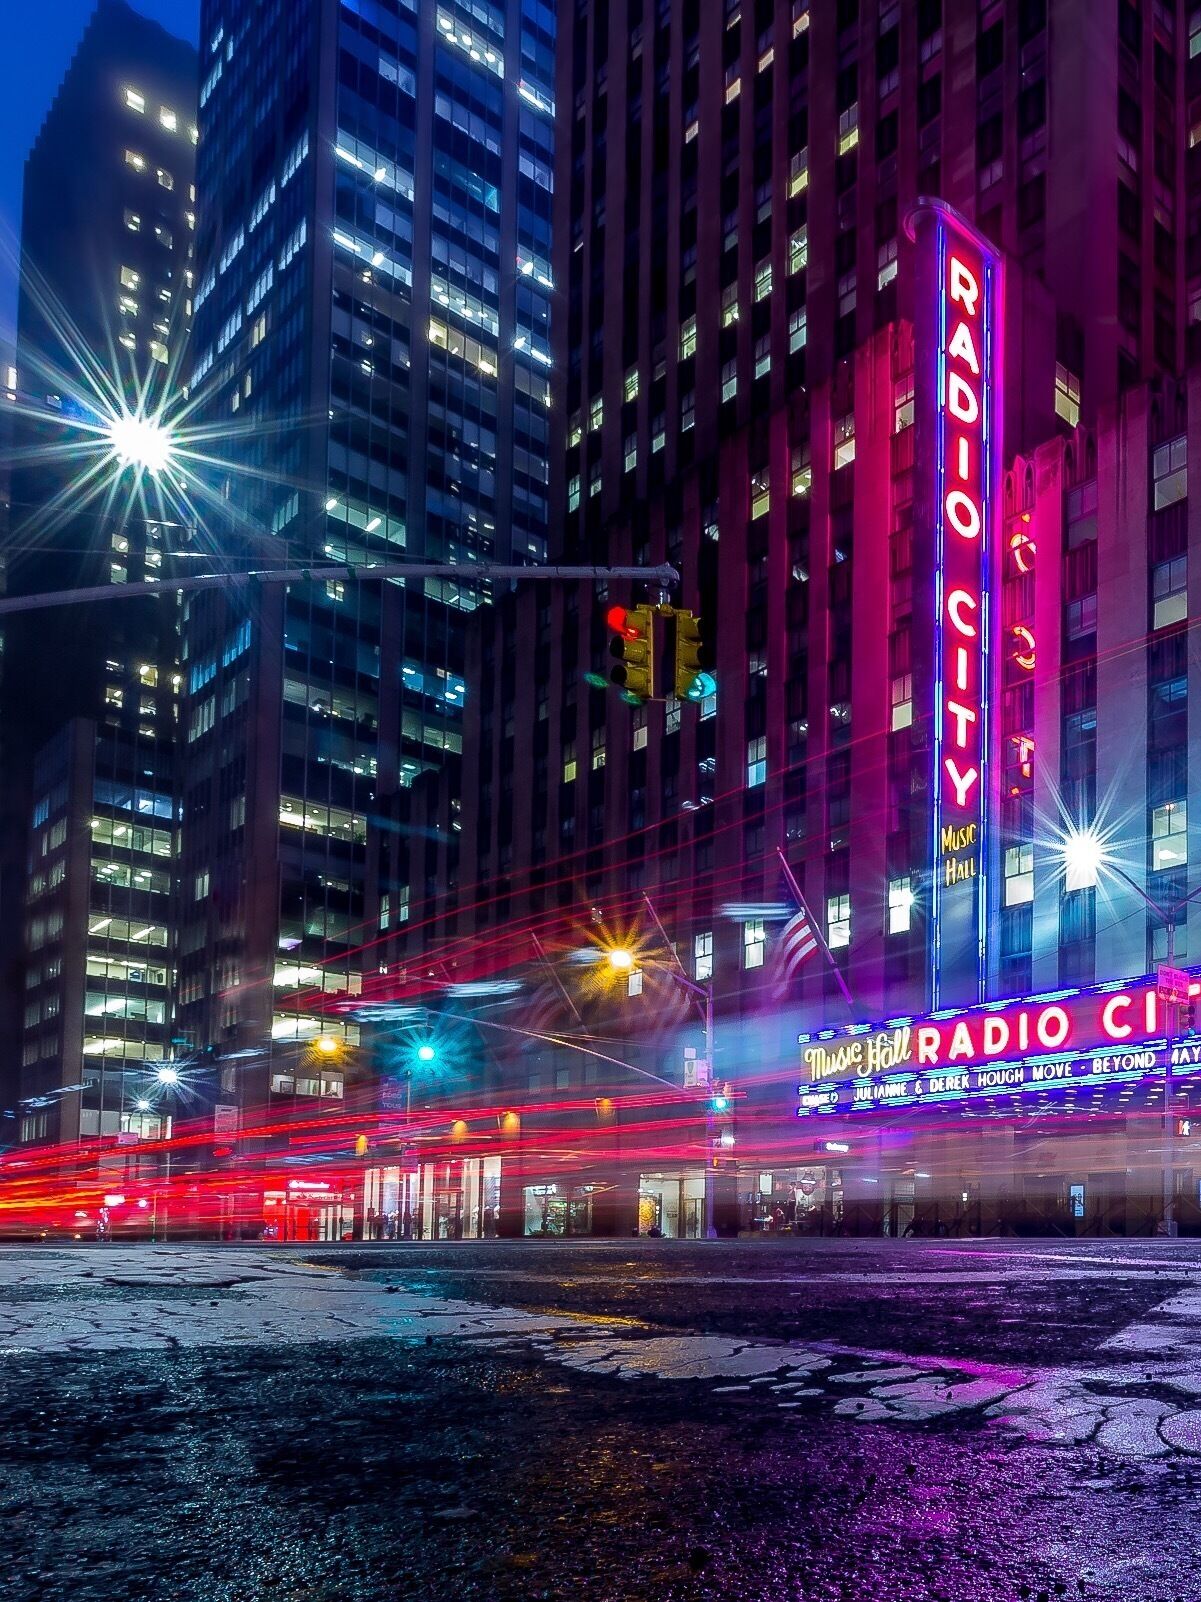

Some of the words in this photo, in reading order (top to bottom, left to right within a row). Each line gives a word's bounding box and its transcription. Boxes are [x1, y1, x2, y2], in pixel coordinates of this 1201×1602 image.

[946, 256, 981, 539] RADIO
[945, 590, 978, 806] CITY
[856, 1026, 912, 1077] Hall
[918, 1006, 1069, 1064] RADIO
[915, 1080, 923, 1094] &
[929, 1075, 970, 1093] DEREK
[978, 1069, 1024, 1087] HOUGH
[1032, 1062, 1072, 1081] MOVE
[1092, 1052, 1156, 1074] BEYOND
